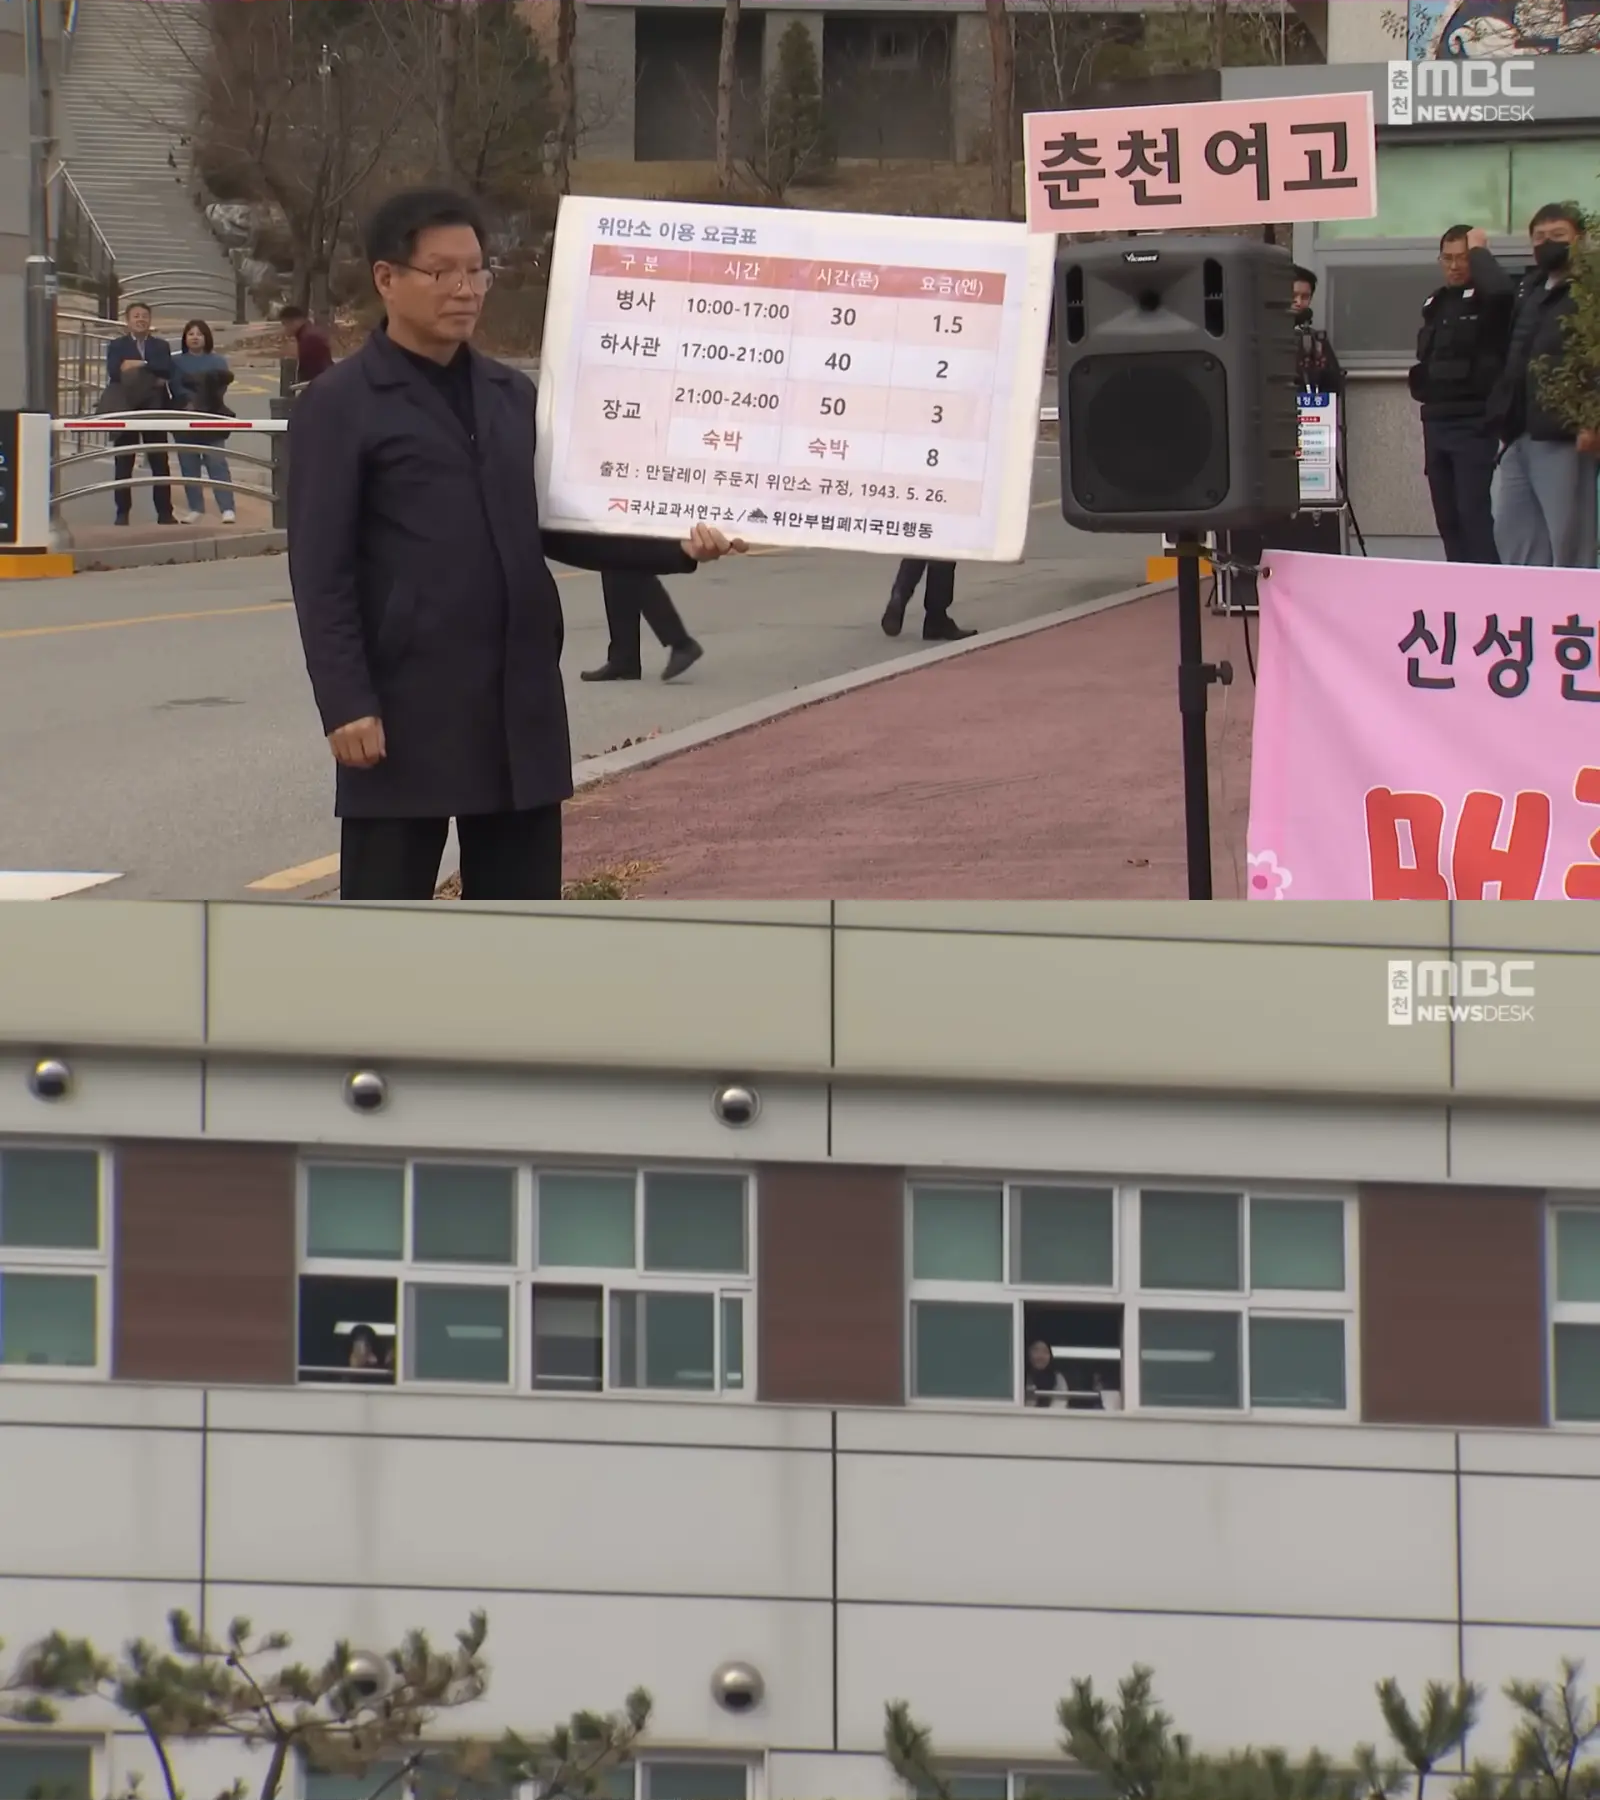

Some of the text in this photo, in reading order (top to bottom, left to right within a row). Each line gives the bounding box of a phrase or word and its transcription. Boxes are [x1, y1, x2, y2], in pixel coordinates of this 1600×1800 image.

[597, 217, 758, 245] 위안소 이용 요금표
[725, 260, 760, 281] 시간
[816, 267, 879, 291] 시간(분)
[920, 276, 983, 298] 요금(엔)
[616, 290, 656, 313] 병사
[687, 298, 790, 320] 10:00-17:00
[830, 307, 857, 327] 30
[932, 314, 964, 334] 1.5
[600, 333, 661, 357] 하사관
[681, 342, 784, 365] 17:00-21:00
[824, 352, 851, 371] 40
[936, 360, 949, 379] 2
[602, 399, 641, 420] 장교
[675, 387, 779, 410] 21:00-24:00
[819, 397, 846, 416] 50
[931, 405, 944, 424] 3
[702, 428, 743, 453] 숙박
[808, 437, 849, 461] 숙박
[926, 448, 939, 467] 8
[600, 461, 630, 479] 출전
[646, 464, 707, 484] 만달레이
[713, 469, 759, 490] 주둔지
[766, 473, 812, 492] 위안소
[819, 479, 853, 498] 규정,
